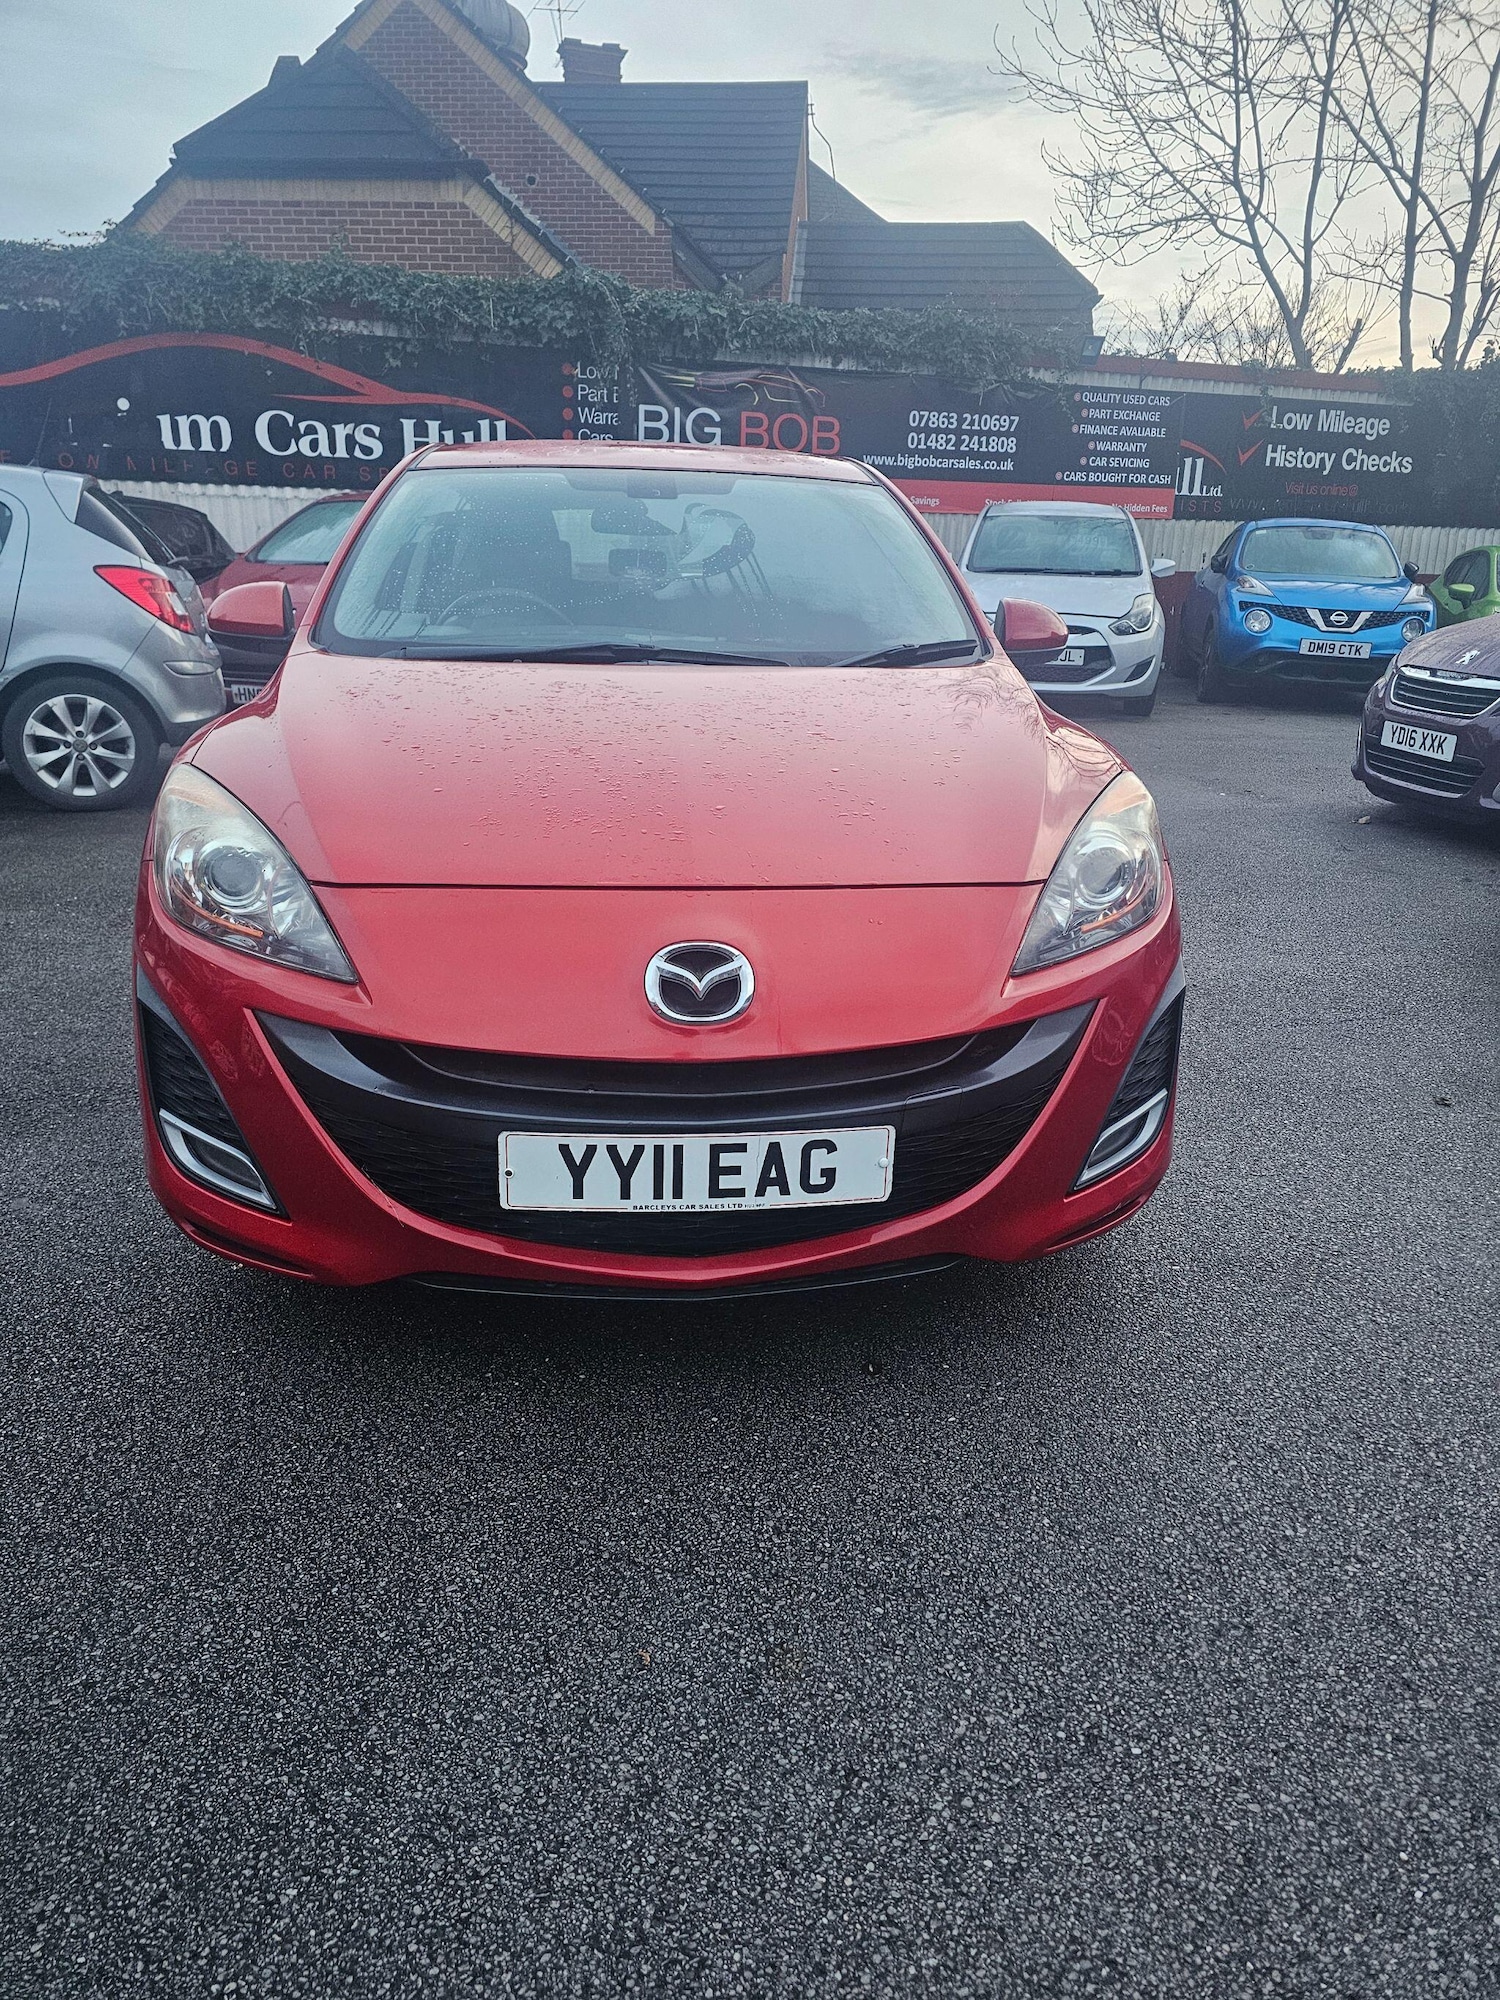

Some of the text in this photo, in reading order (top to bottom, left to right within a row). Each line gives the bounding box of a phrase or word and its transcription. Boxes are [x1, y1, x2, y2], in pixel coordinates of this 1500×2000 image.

[577, 384, 608, 402] Part
[1082, 392, 1171, 406] QUALITY USED CARS
[909, 410, 1019, 432] 07863 210697
[1088, 408, 1161, 421] PART EXCHANGE
[1270, 405, 1391, 440] Low Mileage
[255, 410, 384, 460] Cars
[638, 404, 841, 454] BIG BOB
[1079, 424, 1167, 438] FINANCE AVALIABLE
[907, 432, 1017, 453] 01482 241808
[1096, 441, 1148, 452] WARRANTY
[863, 453, 1014, 471] www.bigbobcarsales.co.uk
[1088, 456, 1150, 468] CAR SEVICING
[1265, 444, 1413, 475] History Checks
[1063, 471, 1172, 484] CARS BOUGHT FOR CASH
[1202, 485, 1223, 497] Ltd.
[910, 496, 940, 507] Savings
[1123, 503, 1151, 513] Hidden
[1151, 504, 1168, 514] Fees
[1307, 642, 1363, 656] DM19 CTK
[1390, 724, 1448, 755] YD16 XXK
[558, 1139, 838, 1201] YY11 EAG
